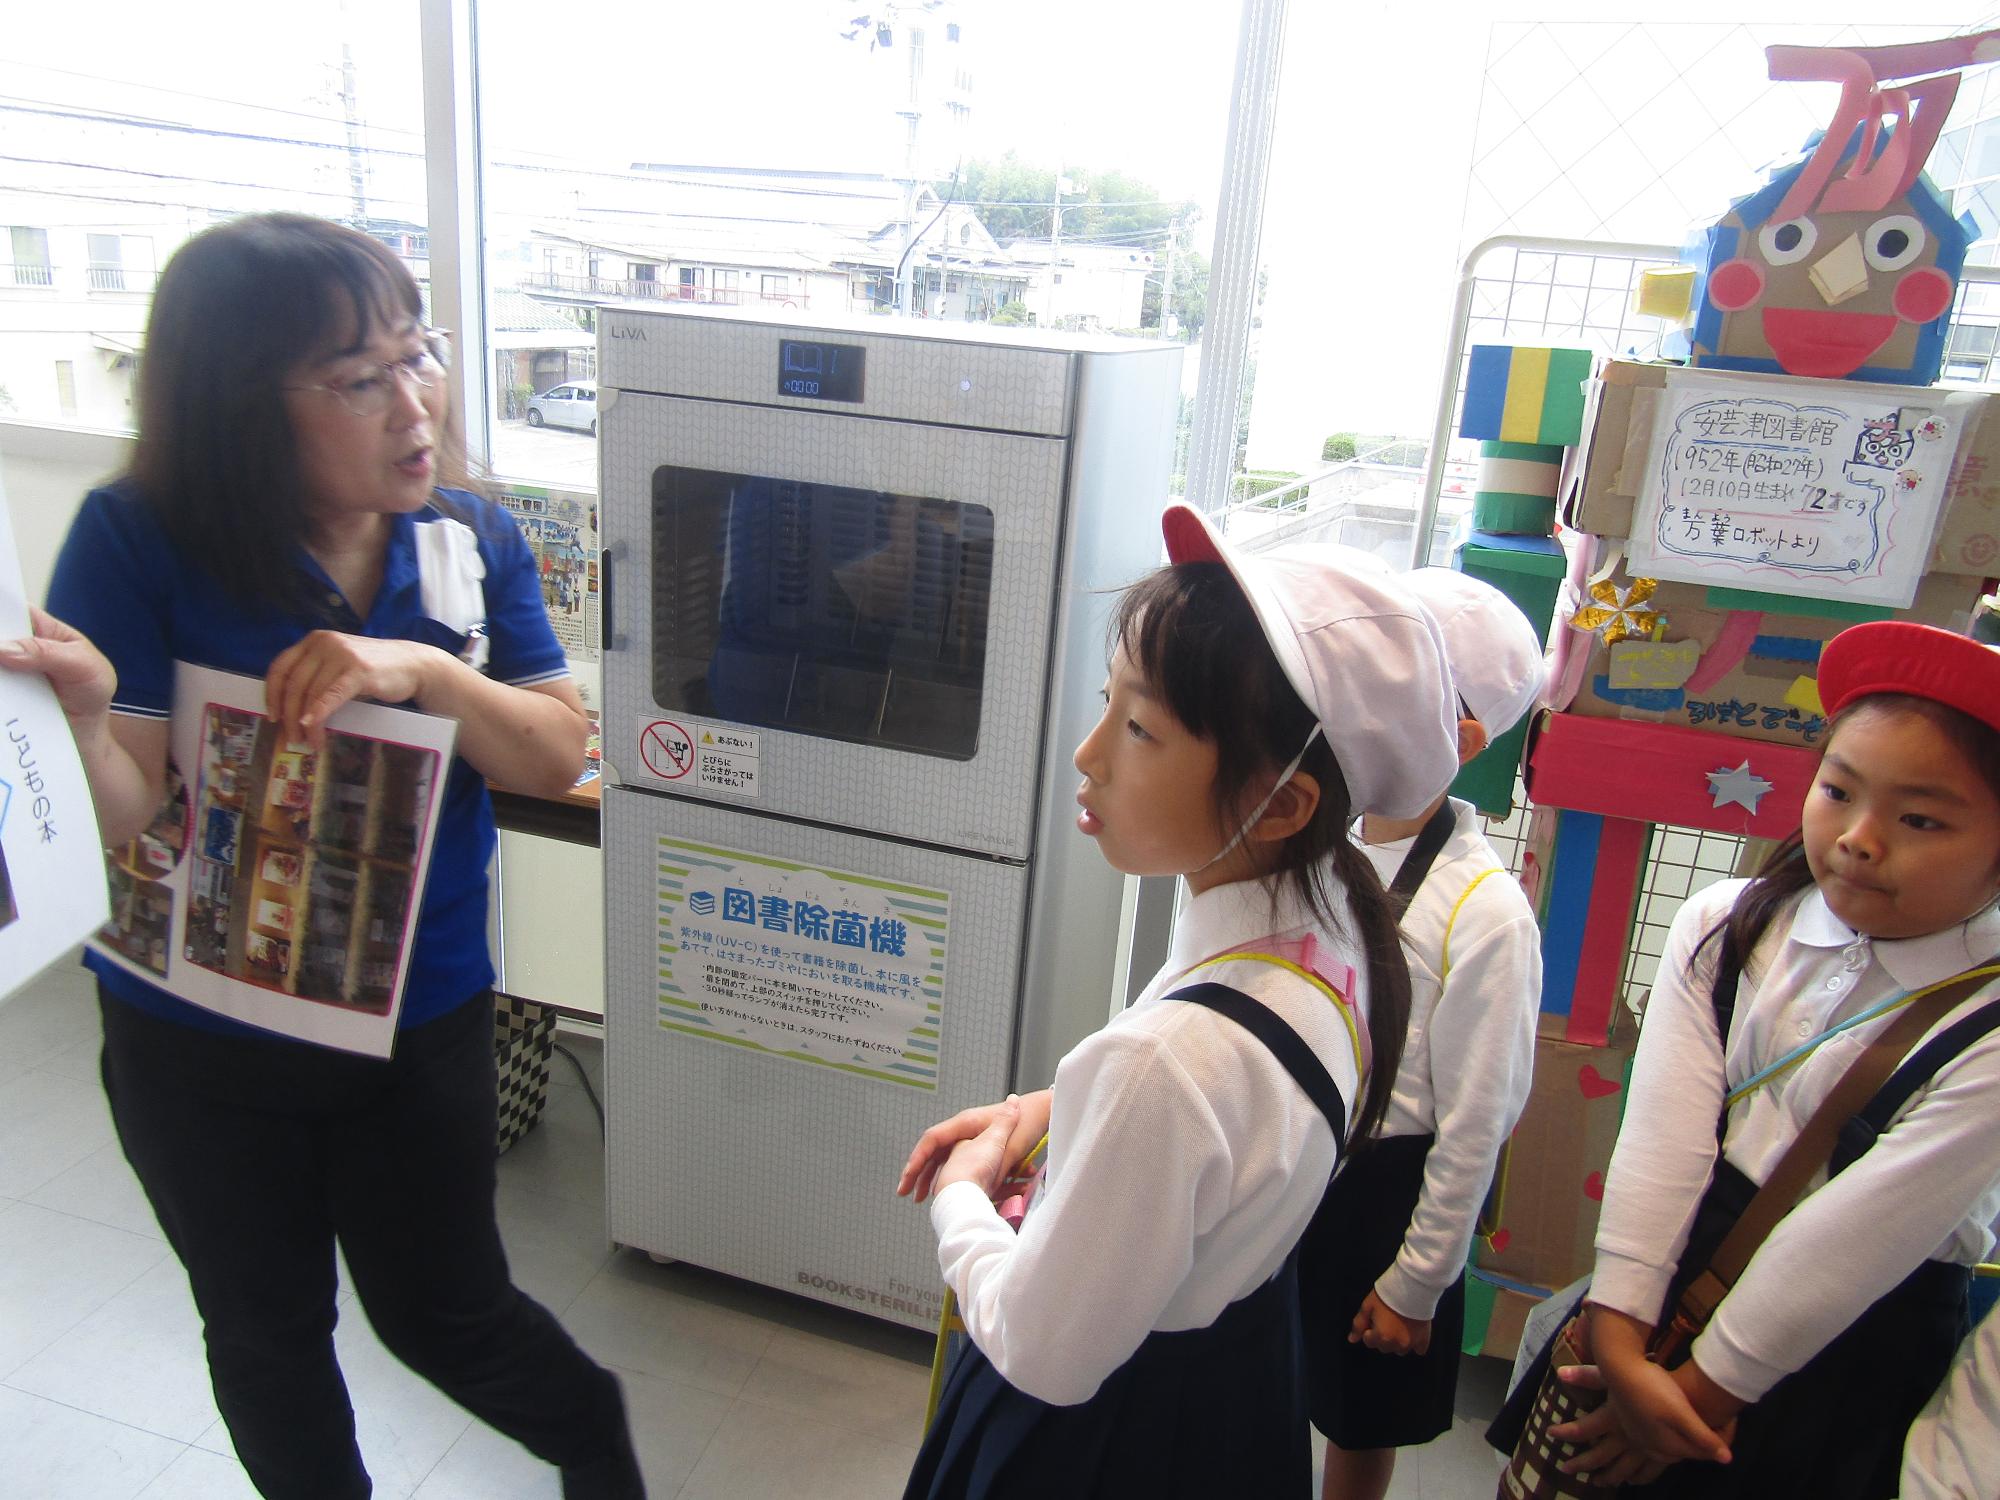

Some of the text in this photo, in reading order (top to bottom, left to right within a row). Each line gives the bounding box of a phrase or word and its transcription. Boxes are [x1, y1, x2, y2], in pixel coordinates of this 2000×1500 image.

[1693, 409, 1838, 447] 安芸津図書館
[1681, 519, 1820, 558] 万葉ロボットより
[717, 736, 753, 749] あぶない！
[702, 755, 732, 767] とびらに
[702, 764, 754, 780] ぶらさがっては
[5, 717, 58, 844] こどもの本
[702, 774, 744, 788] いけません！
[722, 886, 908, 958] 図書除菌機
[680, 939, 917, 1001] あてて、はさまったゴミやにおいを取る機械です。
[888, 1278, 912, 1296] For
